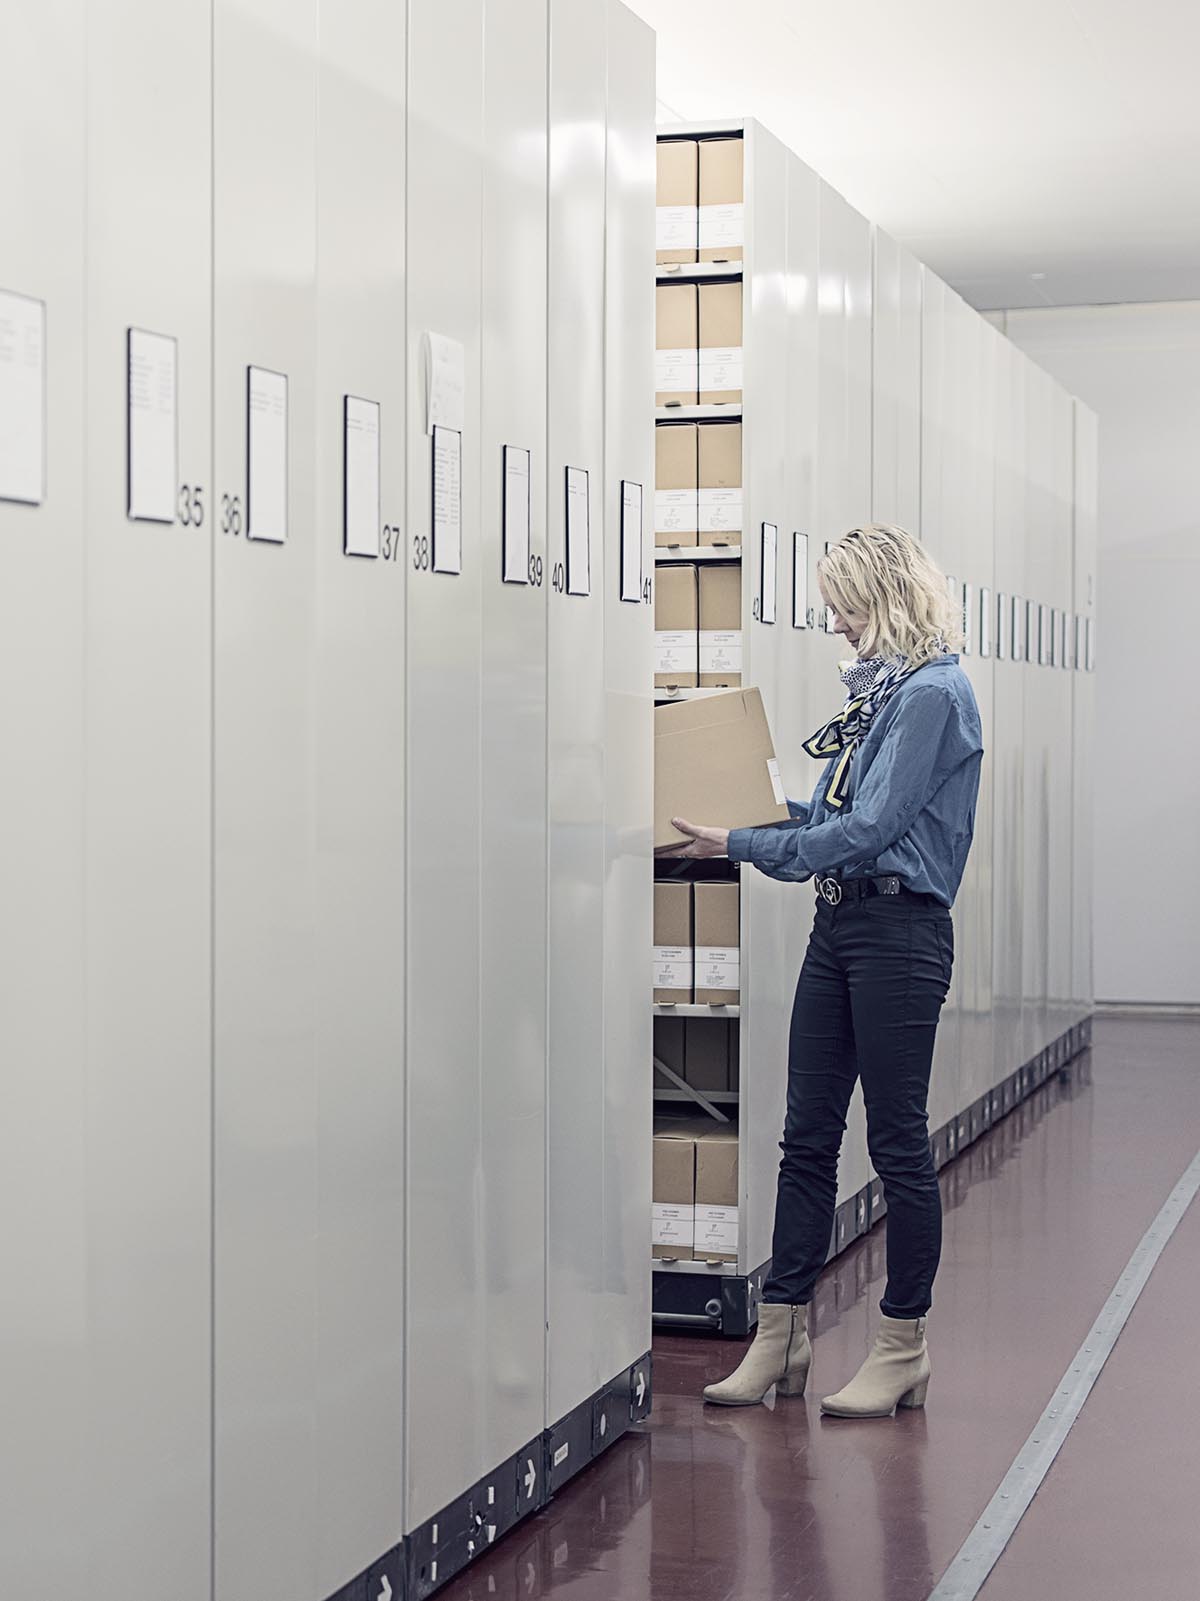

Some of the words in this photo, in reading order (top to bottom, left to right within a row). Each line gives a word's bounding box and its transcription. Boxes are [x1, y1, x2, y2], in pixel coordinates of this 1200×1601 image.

[180, 484, 204, 528] 35
[221, 493, 242, 536] 36
[382, 524, 400, 562] 37
[413, 535, 428, 571] 38
[529, 555, 543, 588] 39
[552, 563, 564, 594] 40
[643, 577, 653, 605] 41
